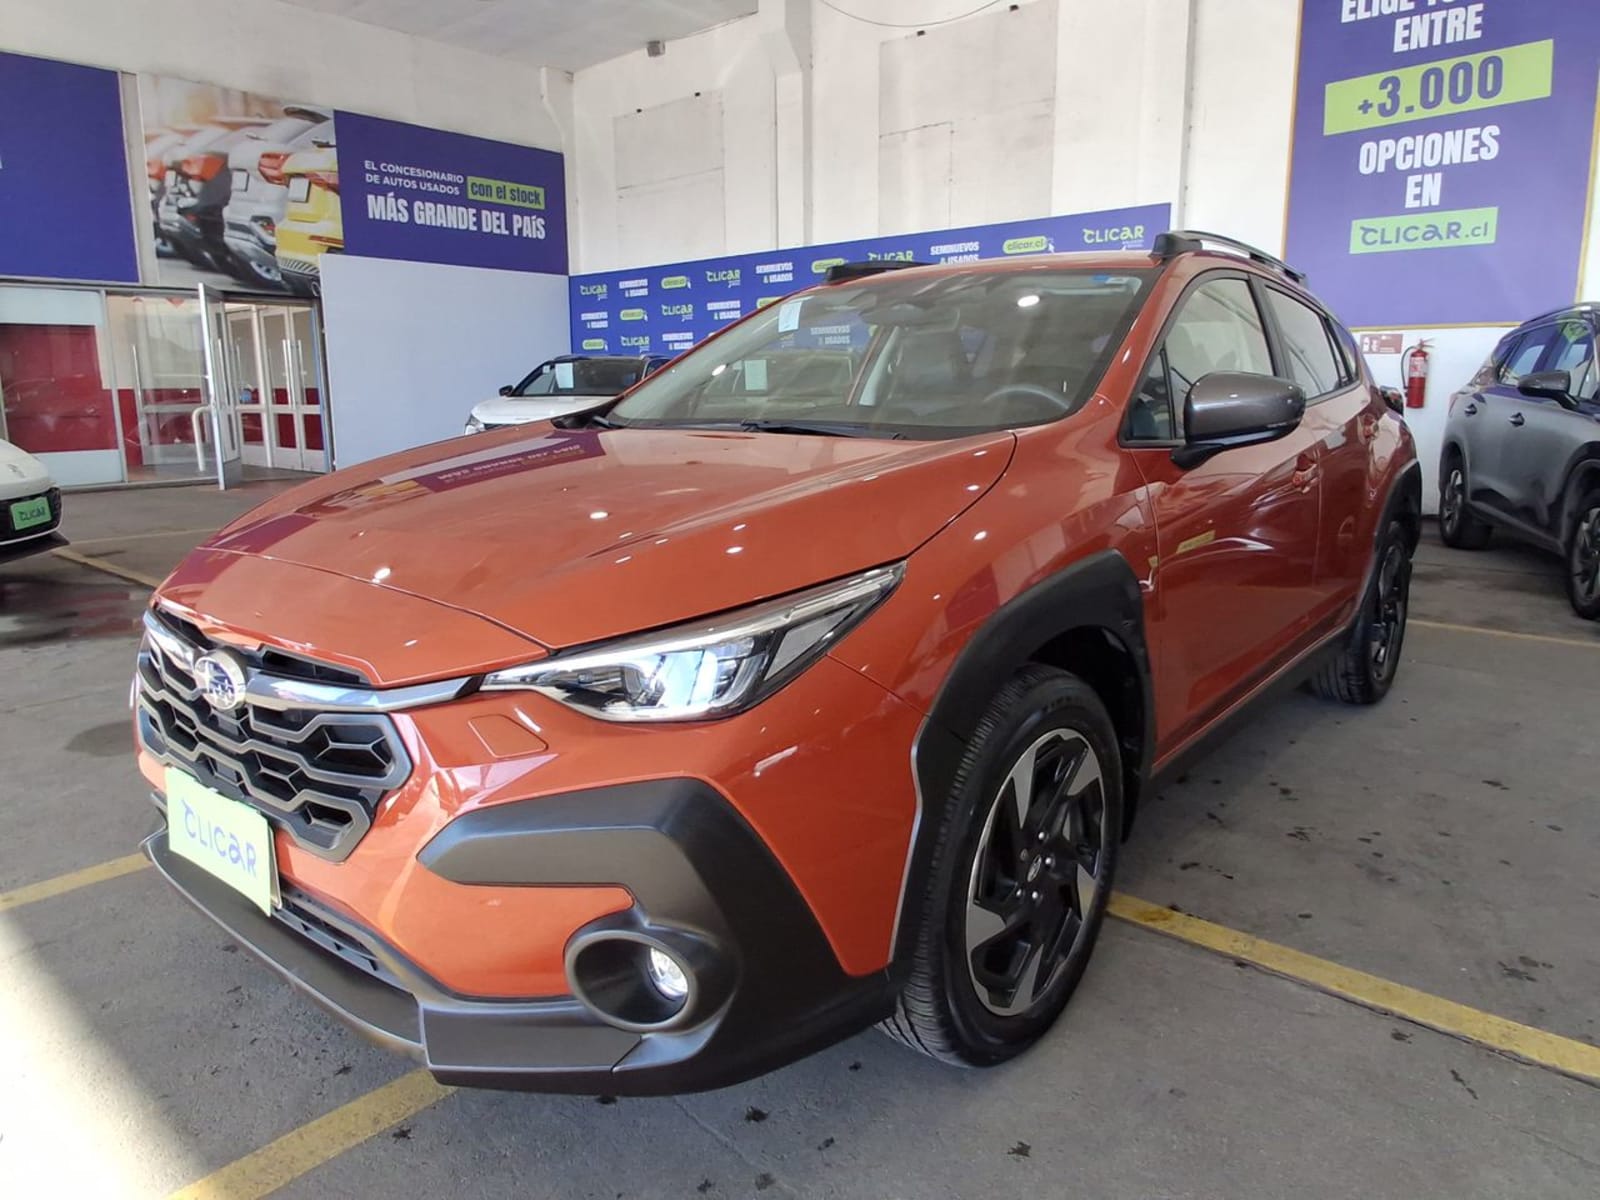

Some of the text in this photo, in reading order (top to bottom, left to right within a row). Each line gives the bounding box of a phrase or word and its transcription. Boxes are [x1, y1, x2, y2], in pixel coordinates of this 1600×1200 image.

[1393, 3, 1484, 52] ENTRE
[1358, 55, 1504, 118] +3.000
[1359, 125, 1500, 175] OPCIONES
[364, 160, 464, 184] EL CONCESIONARIO
[365, 173, 460, 196] DE AUTOS USADOS
[1405, 172, 1442, 208] EN
[470, 181, 542, 205] con el stock
[367, 192, 546, 240] MÁS GRANDE DEL PAÍS
[1007, 238, 1044, 251] clicar.cl
